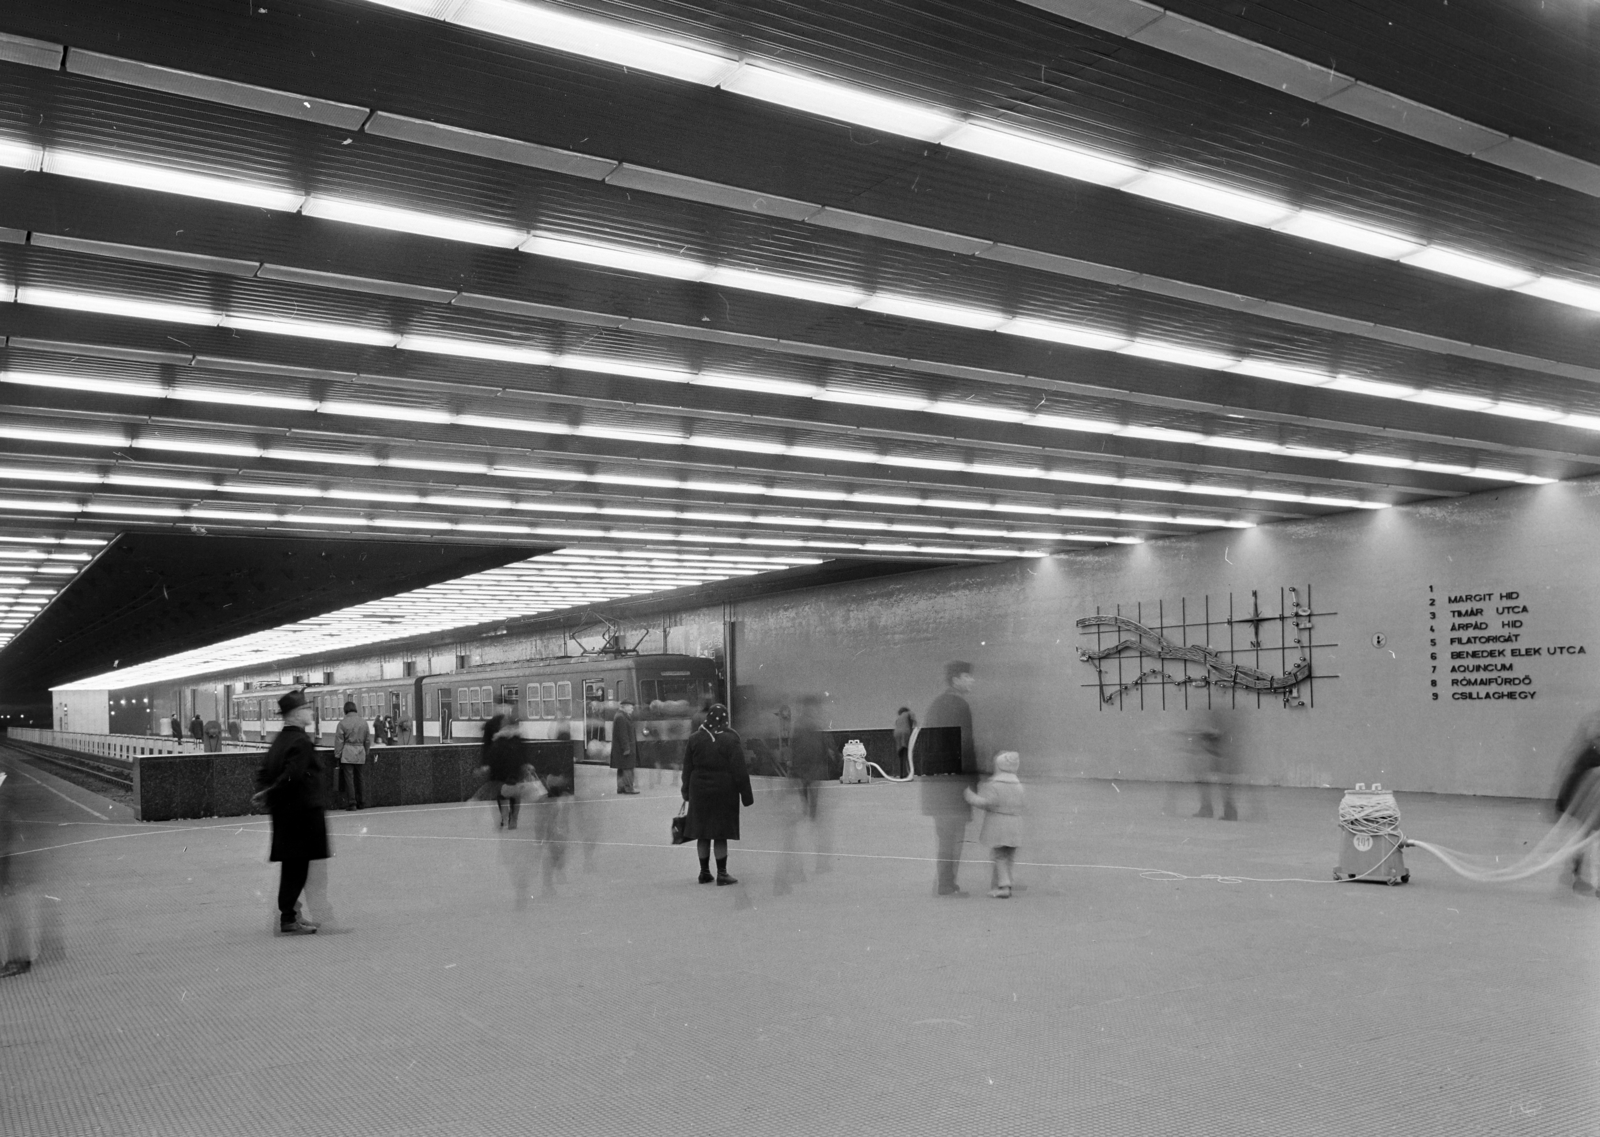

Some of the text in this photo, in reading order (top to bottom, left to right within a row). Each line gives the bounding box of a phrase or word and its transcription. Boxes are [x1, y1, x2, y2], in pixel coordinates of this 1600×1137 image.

[1428, 584, 1434, 593] 1
[1428, 591, 1520, 607] 2 MARGIT HID
[1429, 604, 1529, 620] 3 TIMÁR UTCA
[1429, 619, 1524, 633] 4 ÁRPÁD HID
[1430, 631, 1521, 647] 5 FILATORIGÁT
[1430, 645, 1587, 661] 6 BENEDEK ELEK UTCA
[1431, 662, 1514, 674] 7 AQUINCUM
[1430, 679, 1438, 688] 8
[1431, 690, 1537, 701] 9 CSILLAGHEGY
